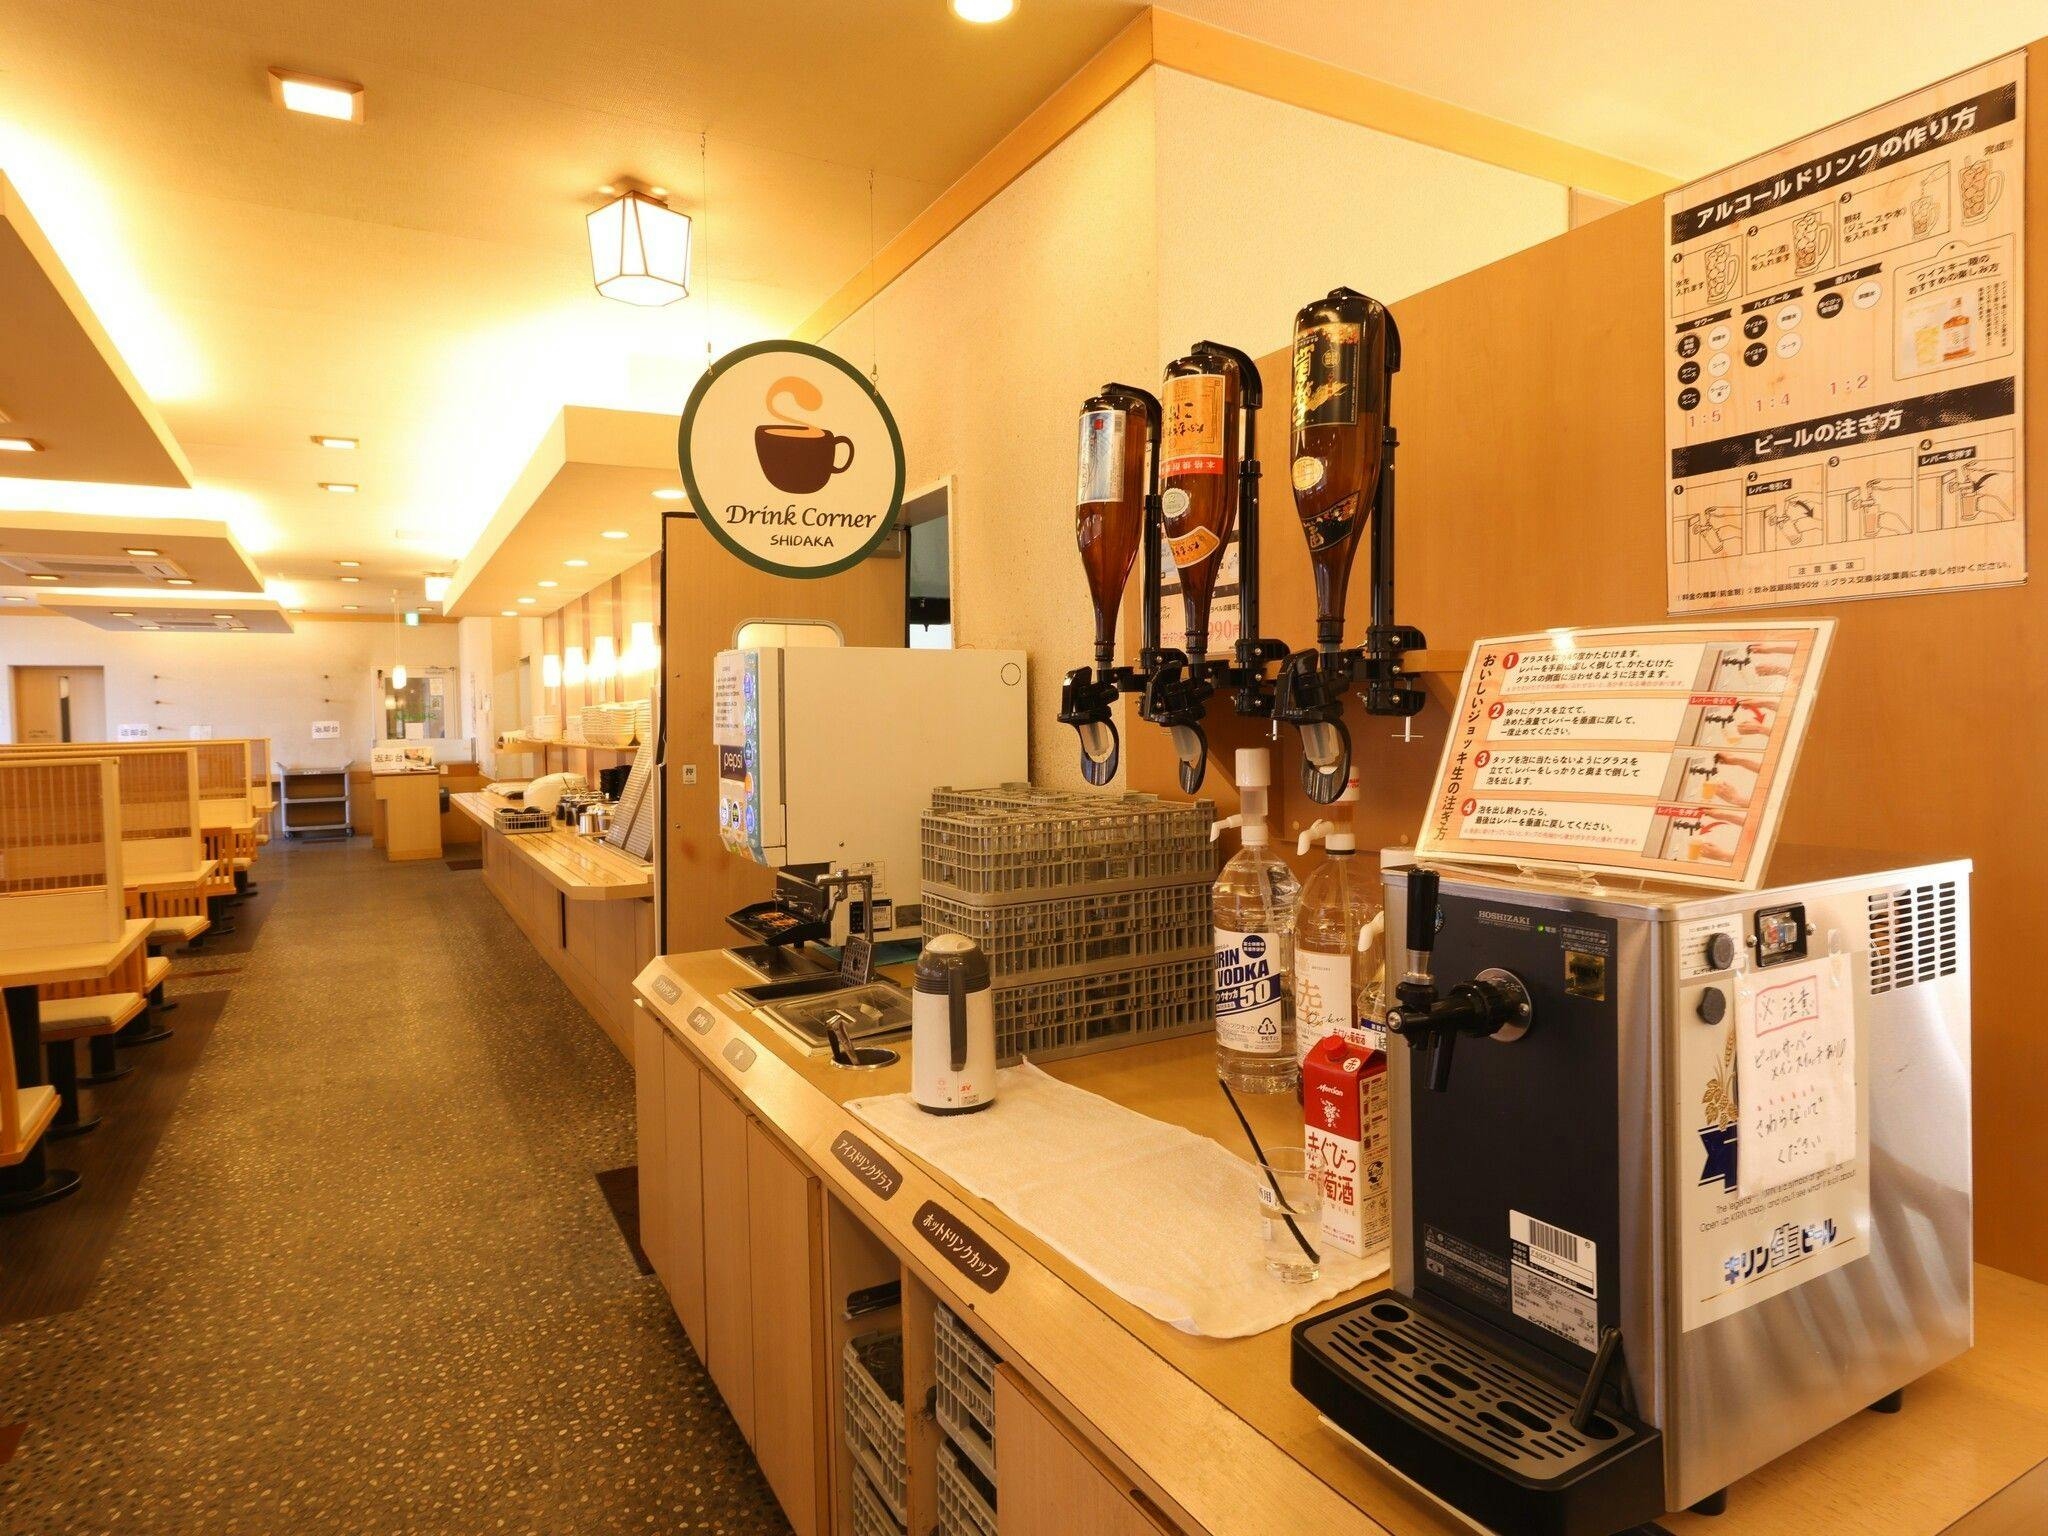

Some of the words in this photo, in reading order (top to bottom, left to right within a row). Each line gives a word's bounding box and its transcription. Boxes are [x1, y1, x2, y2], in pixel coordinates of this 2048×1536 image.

[1697, 105, 1978, 228] アルコールドリンクの作り方
[1754, 408, 1903, 455] ビールの注ぎ方
[726, 505, 797, 526] Drink
[801, 507, 877, 528] Corner
[770, 534, 834, 547] SHIDAKA
[724, 751, 743, 771] pepsi
[1434, 654, 1497, 842] おいしいジョッキ生の注ぎ方
[1479, 910, 1531, 925] HOSHIZAKI
[1217, 959, 1269, 988] VODKA
[1240, 980, 1271, 1008] 50
[838, 1139, 893, 1193] アイスドリンクグラス
[922, 1213, 999, 1278] ホットドリンクカップ
[1725, 1217, 1837, 1285] キリン生ビール
